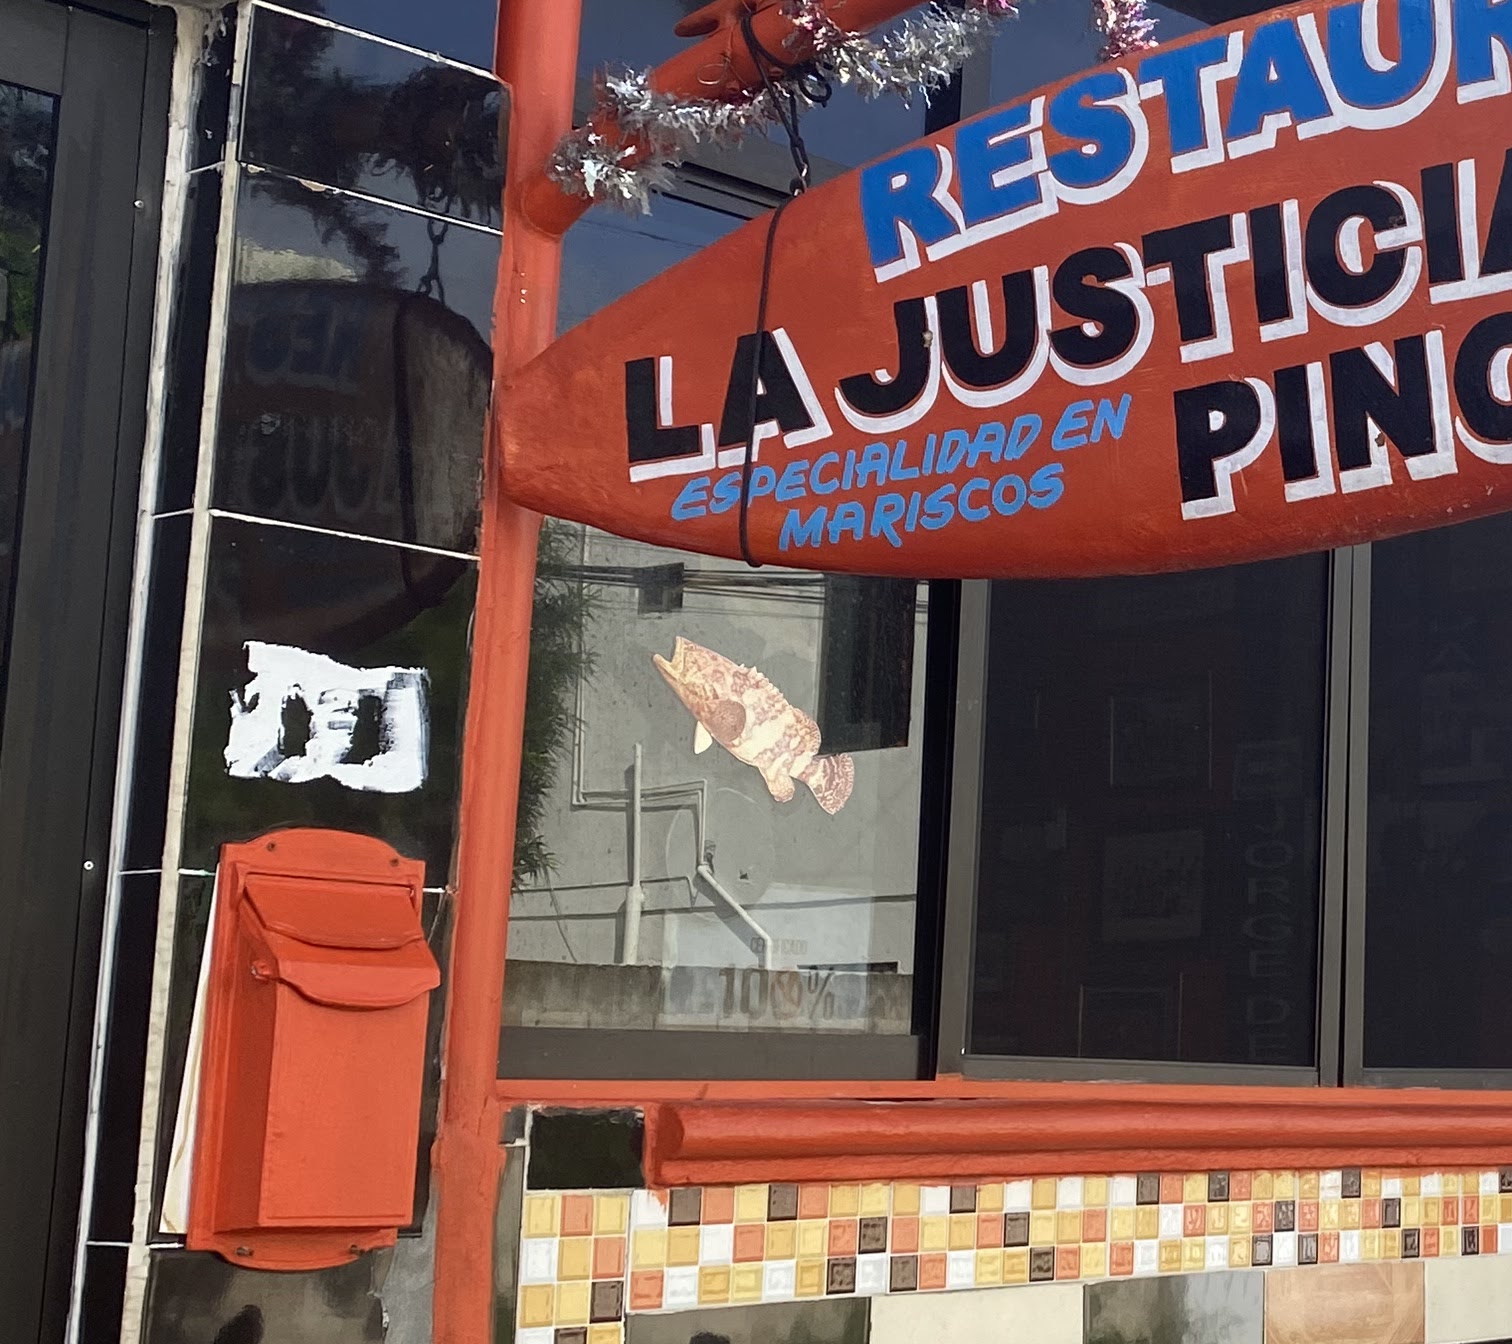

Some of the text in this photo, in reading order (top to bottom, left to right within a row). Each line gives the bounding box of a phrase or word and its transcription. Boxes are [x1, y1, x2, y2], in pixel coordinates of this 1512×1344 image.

[622, 324, 833, 483] LA
[670, 392, 1132, 521] ESPECIALIDAD EN
[777, 462, 1065, 552] MARISCOS
